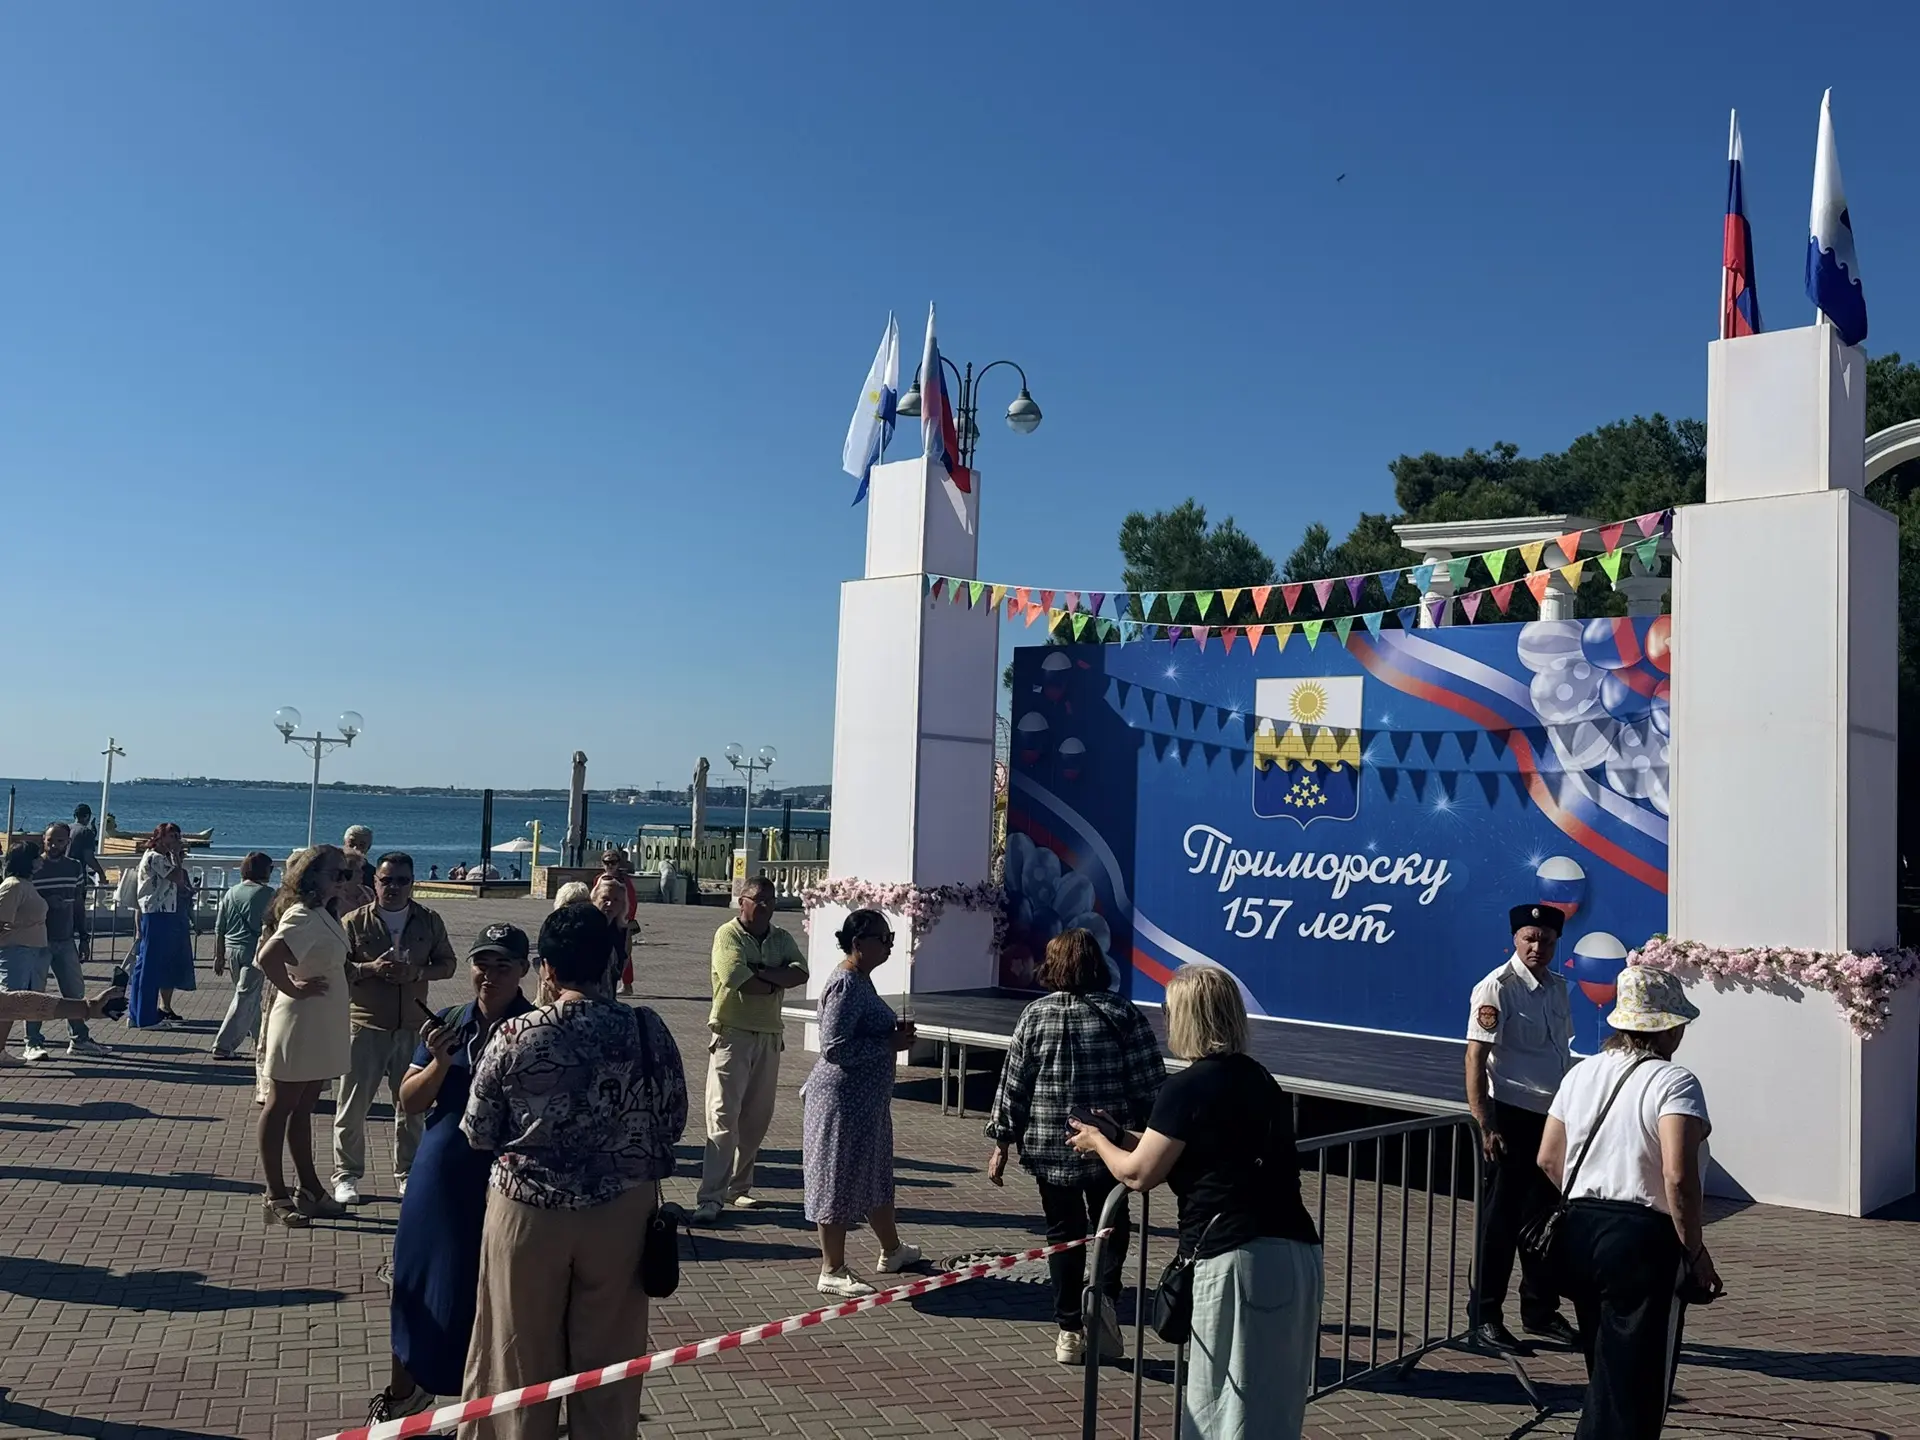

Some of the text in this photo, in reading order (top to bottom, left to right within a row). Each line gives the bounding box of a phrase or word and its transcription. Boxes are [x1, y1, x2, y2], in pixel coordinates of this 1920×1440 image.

[1182, 823, 1452, 905] Приморску
[1222, 896, 1396, 944] 157 лет
